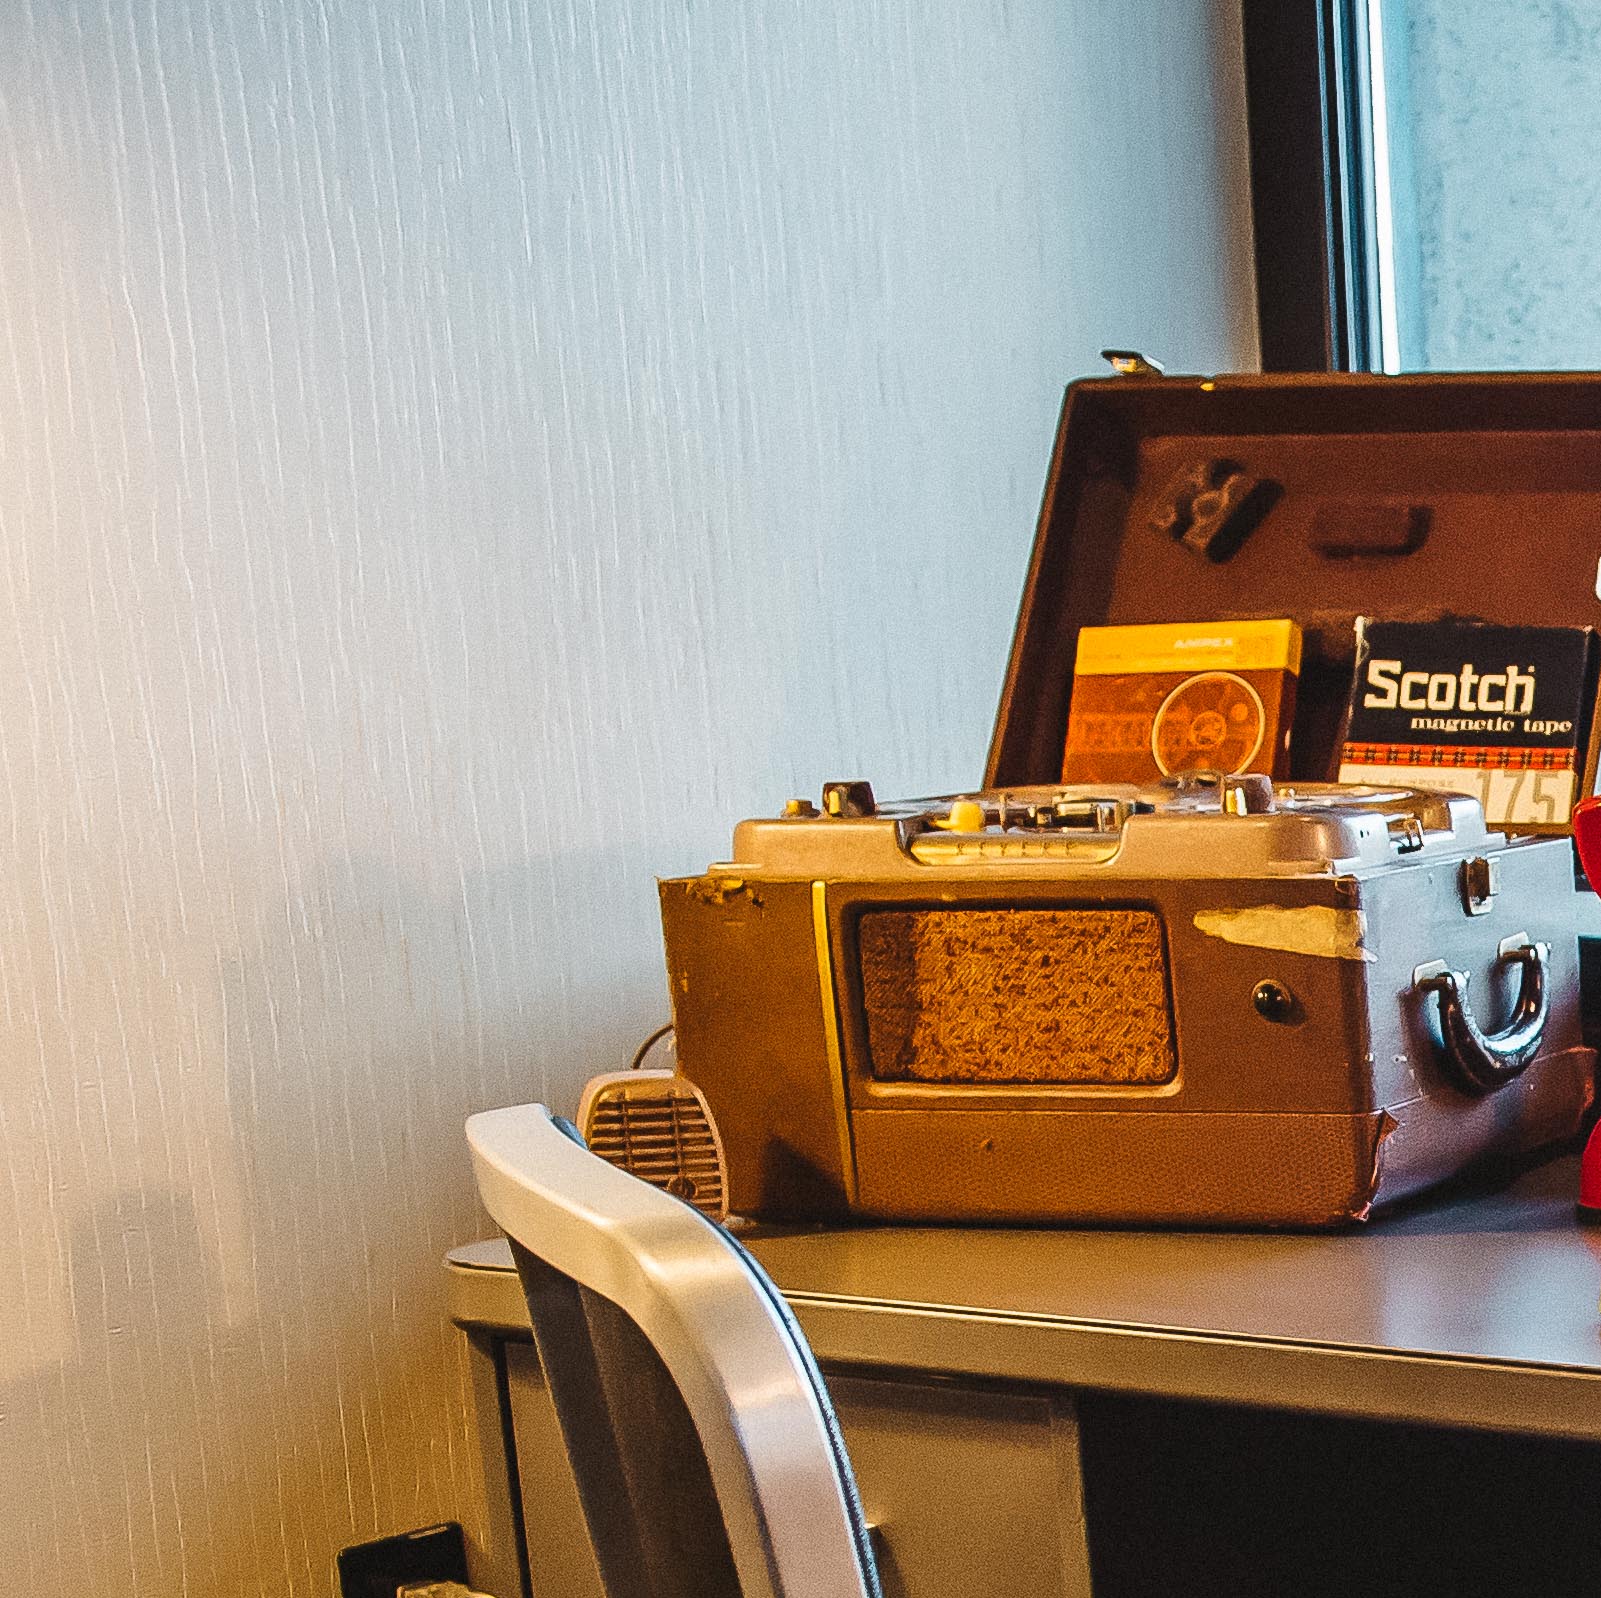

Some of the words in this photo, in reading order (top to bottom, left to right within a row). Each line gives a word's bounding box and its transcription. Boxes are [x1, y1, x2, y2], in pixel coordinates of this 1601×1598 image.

[1364, 659, 1535, 712] Scotch
[1411, 717, 1514, 733] magnetic
[1523, 718, 1573, 736] tape
[1476, 768, 1558, 823] 175
